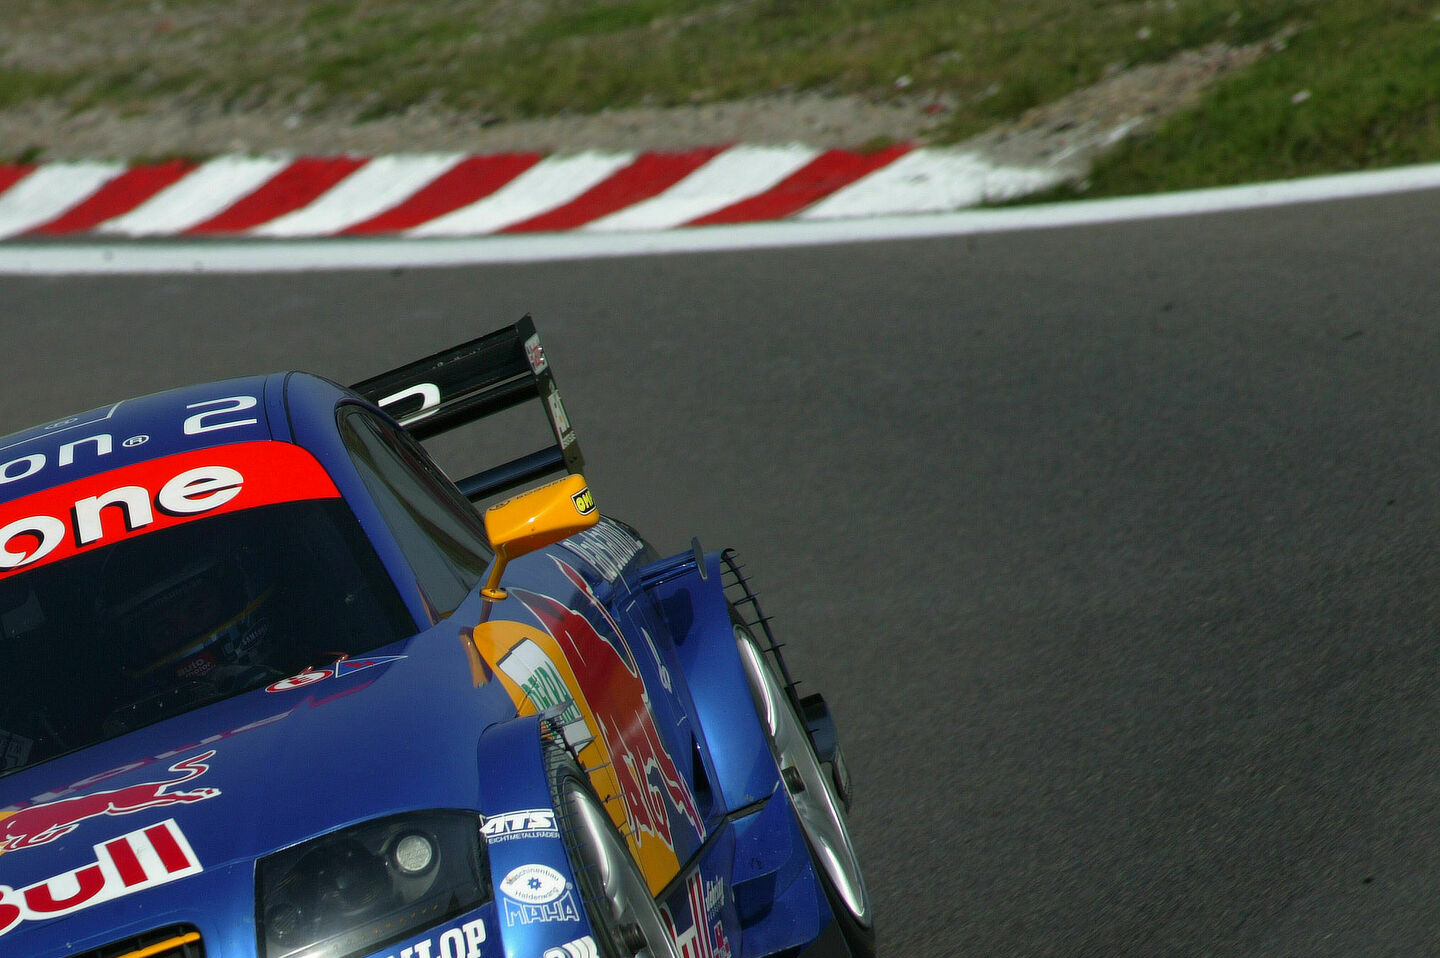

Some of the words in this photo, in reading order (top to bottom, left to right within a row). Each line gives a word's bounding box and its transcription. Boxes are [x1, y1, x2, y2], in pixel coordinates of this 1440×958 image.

[184, 396, 257, 435] 2
[479, 811, 556, 835] ATS
[503, 890, 580, 927] MAHA
